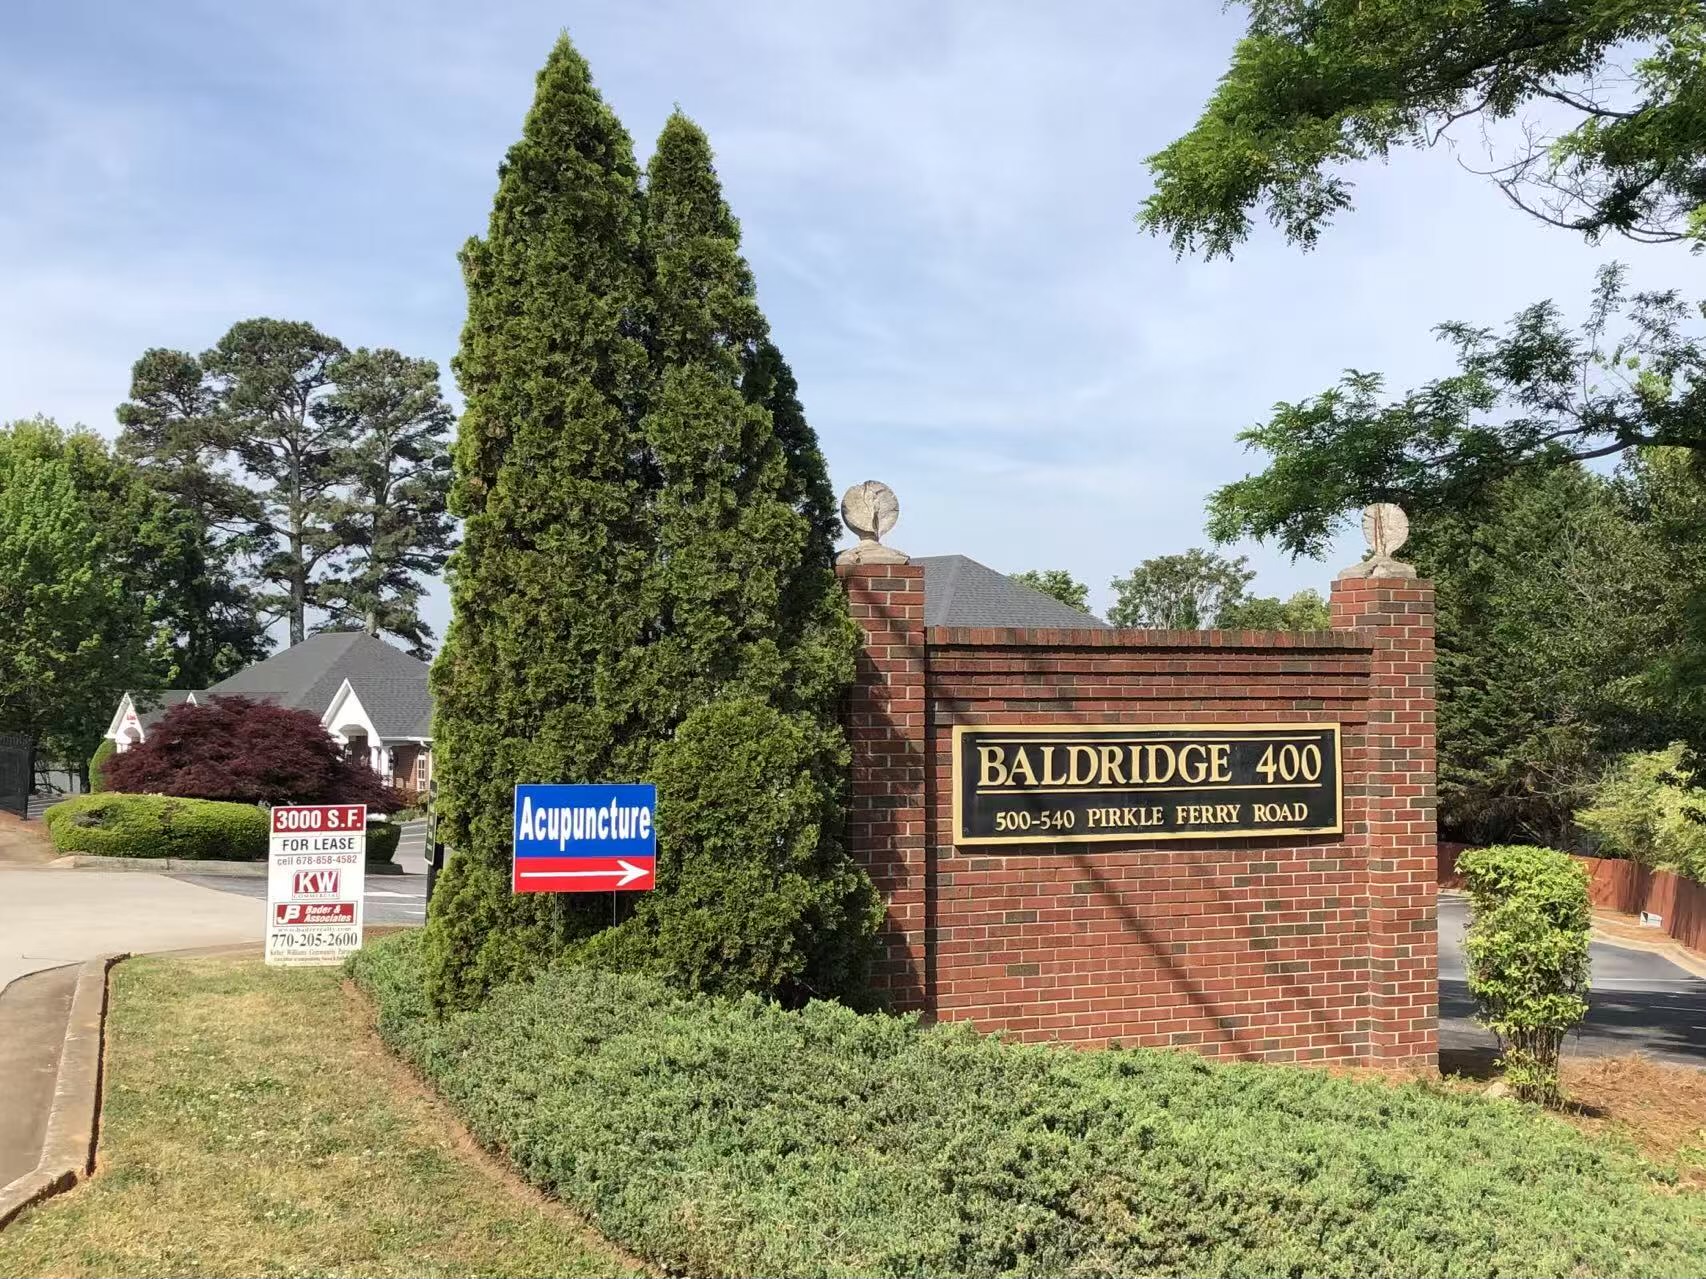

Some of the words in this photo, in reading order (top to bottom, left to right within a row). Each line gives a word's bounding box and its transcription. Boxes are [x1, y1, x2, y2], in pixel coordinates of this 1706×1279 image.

[976, 743, 1232, 787] BALDRIDGE
[1256, 743, 1322, 784] 400
[276, 810, 321, 829] 3000
[328, 809, 361, 828] S.F.
[519, 796, 651, 851] Acupuncture
[996, 810, 1075, 831] 500-540
[1087, 807, 1164, 828] PIRKLE
[1175, 805, 1241, 826] FERRY
[1254, 803, 1308, 823] ROAD
[283, 839, 308, 851] FOR
[314, 838, 354, 850] LEASE
[277, 856, 293, 866] cell
[296, 855, 357, 865] 678-858-4582
[298, 871, 338, 893] KW
[304, 914, 352, 923] Associates
[305, 905, 333, 915] Bader
[333, 905, 341, 914] &
[272, 932, 358, 947] 770-205-2600
